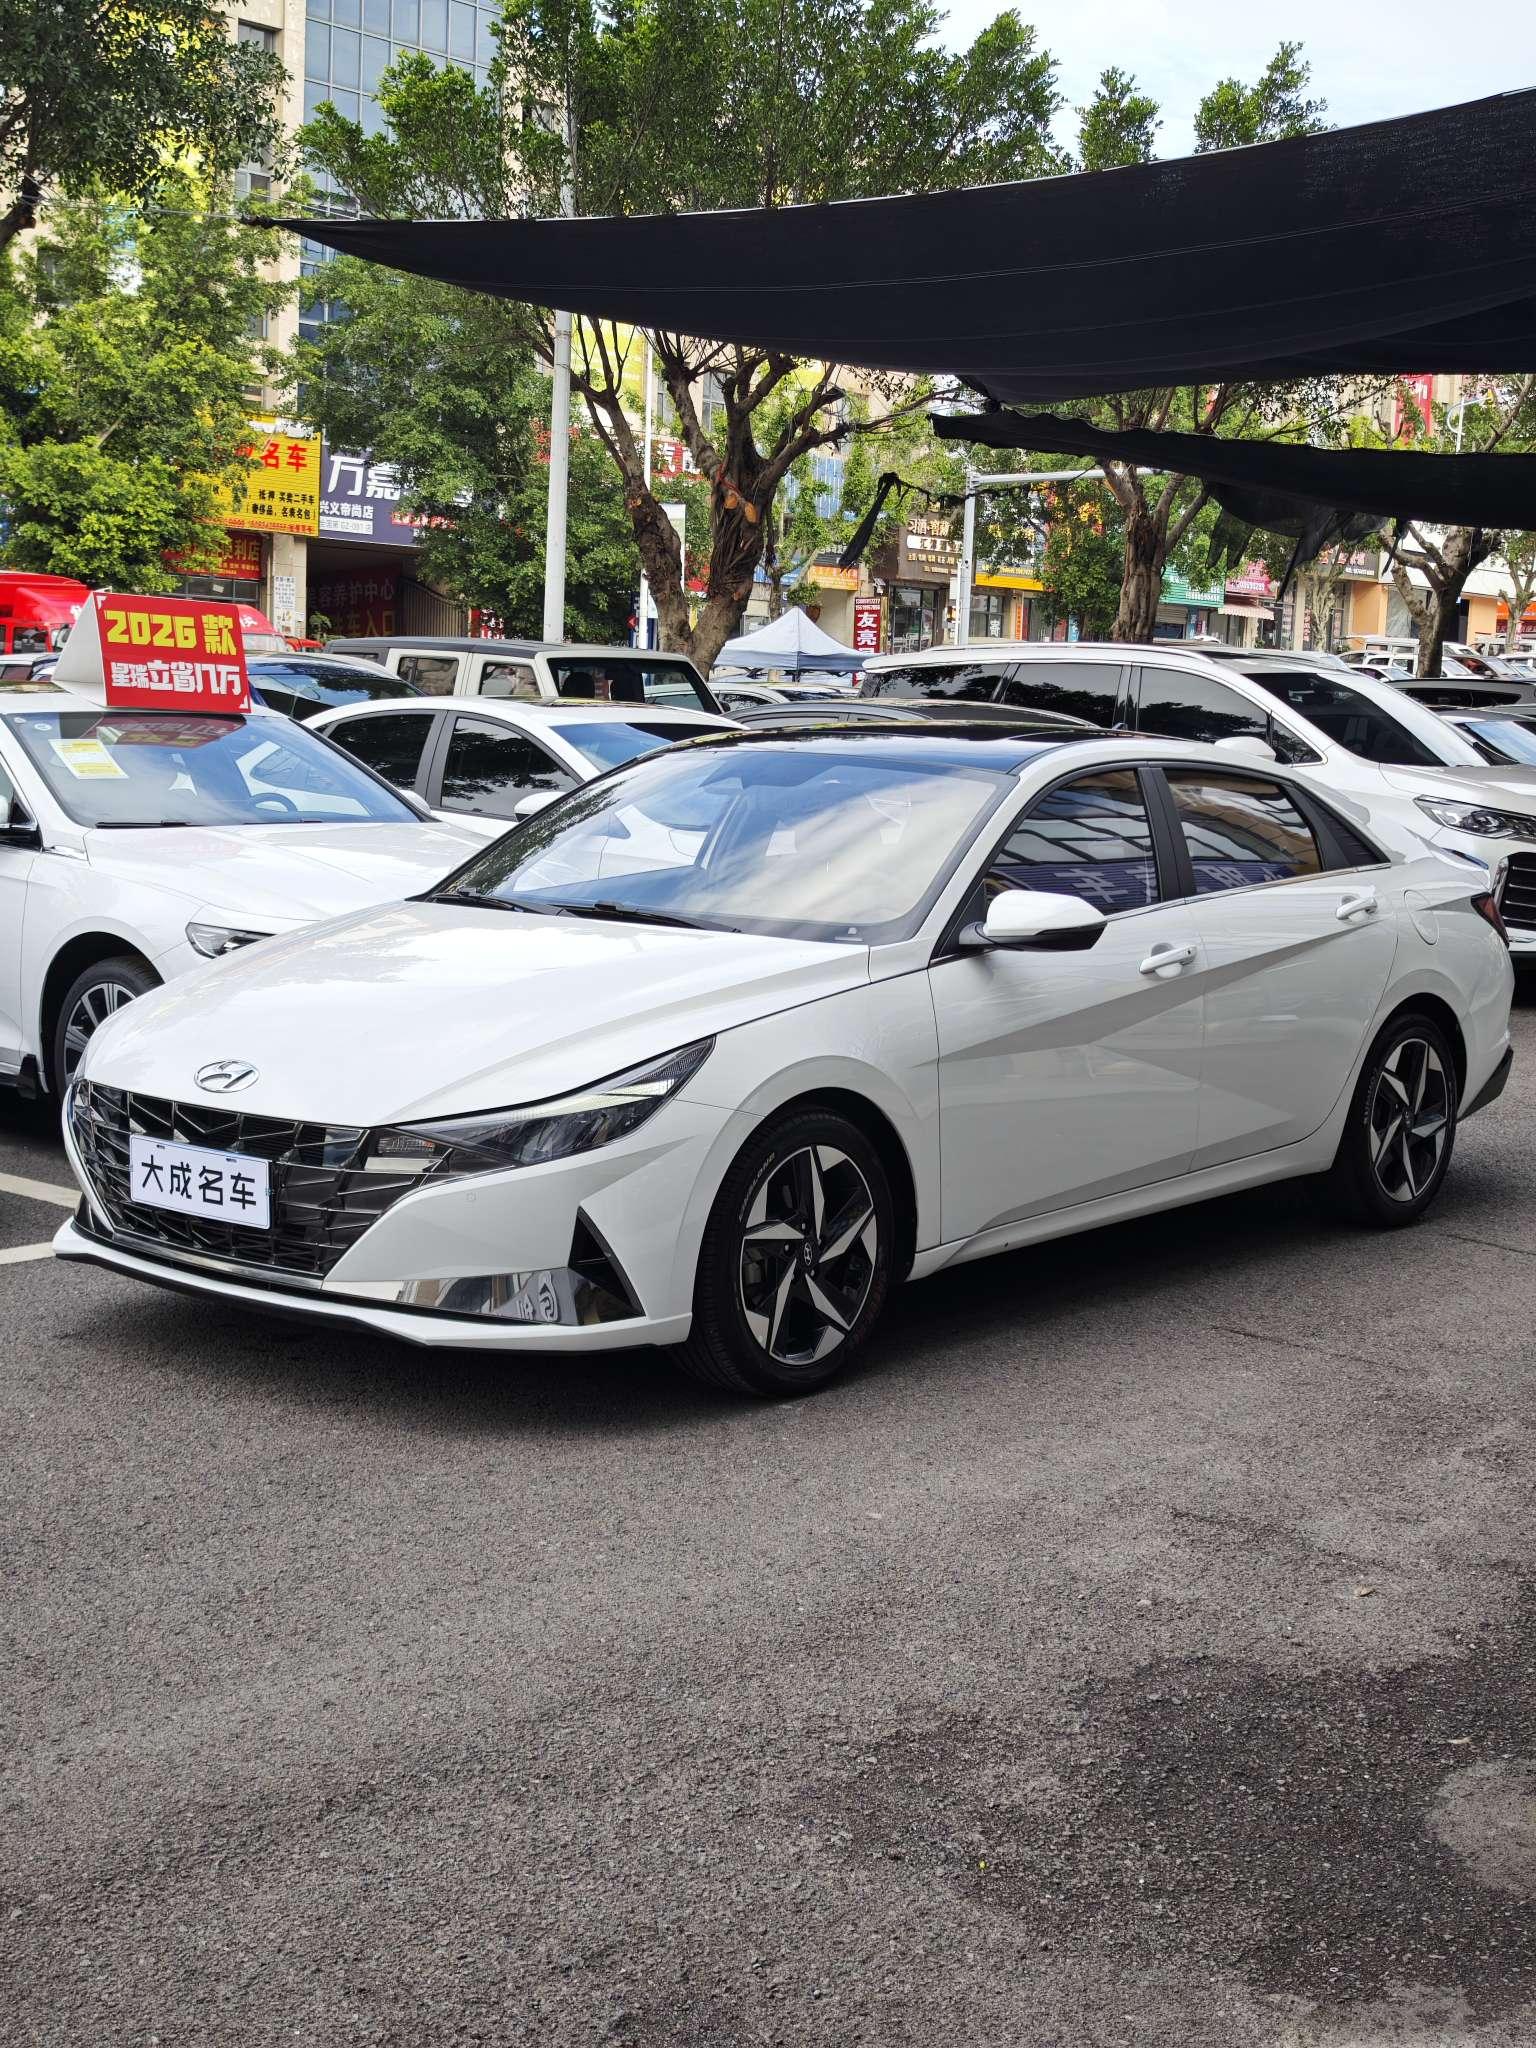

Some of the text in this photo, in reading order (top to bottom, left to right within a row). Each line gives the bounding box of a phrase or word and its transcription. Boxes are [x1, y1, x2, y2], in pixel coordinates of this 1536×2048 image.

[320, 500, 374, 520] 兴义帝尚店
[104, 610, 237, 656] 2026 款
[111, 660, 242, 696] 星瑞立省几万
[141, 1154, 257, 1210] 大成名车
